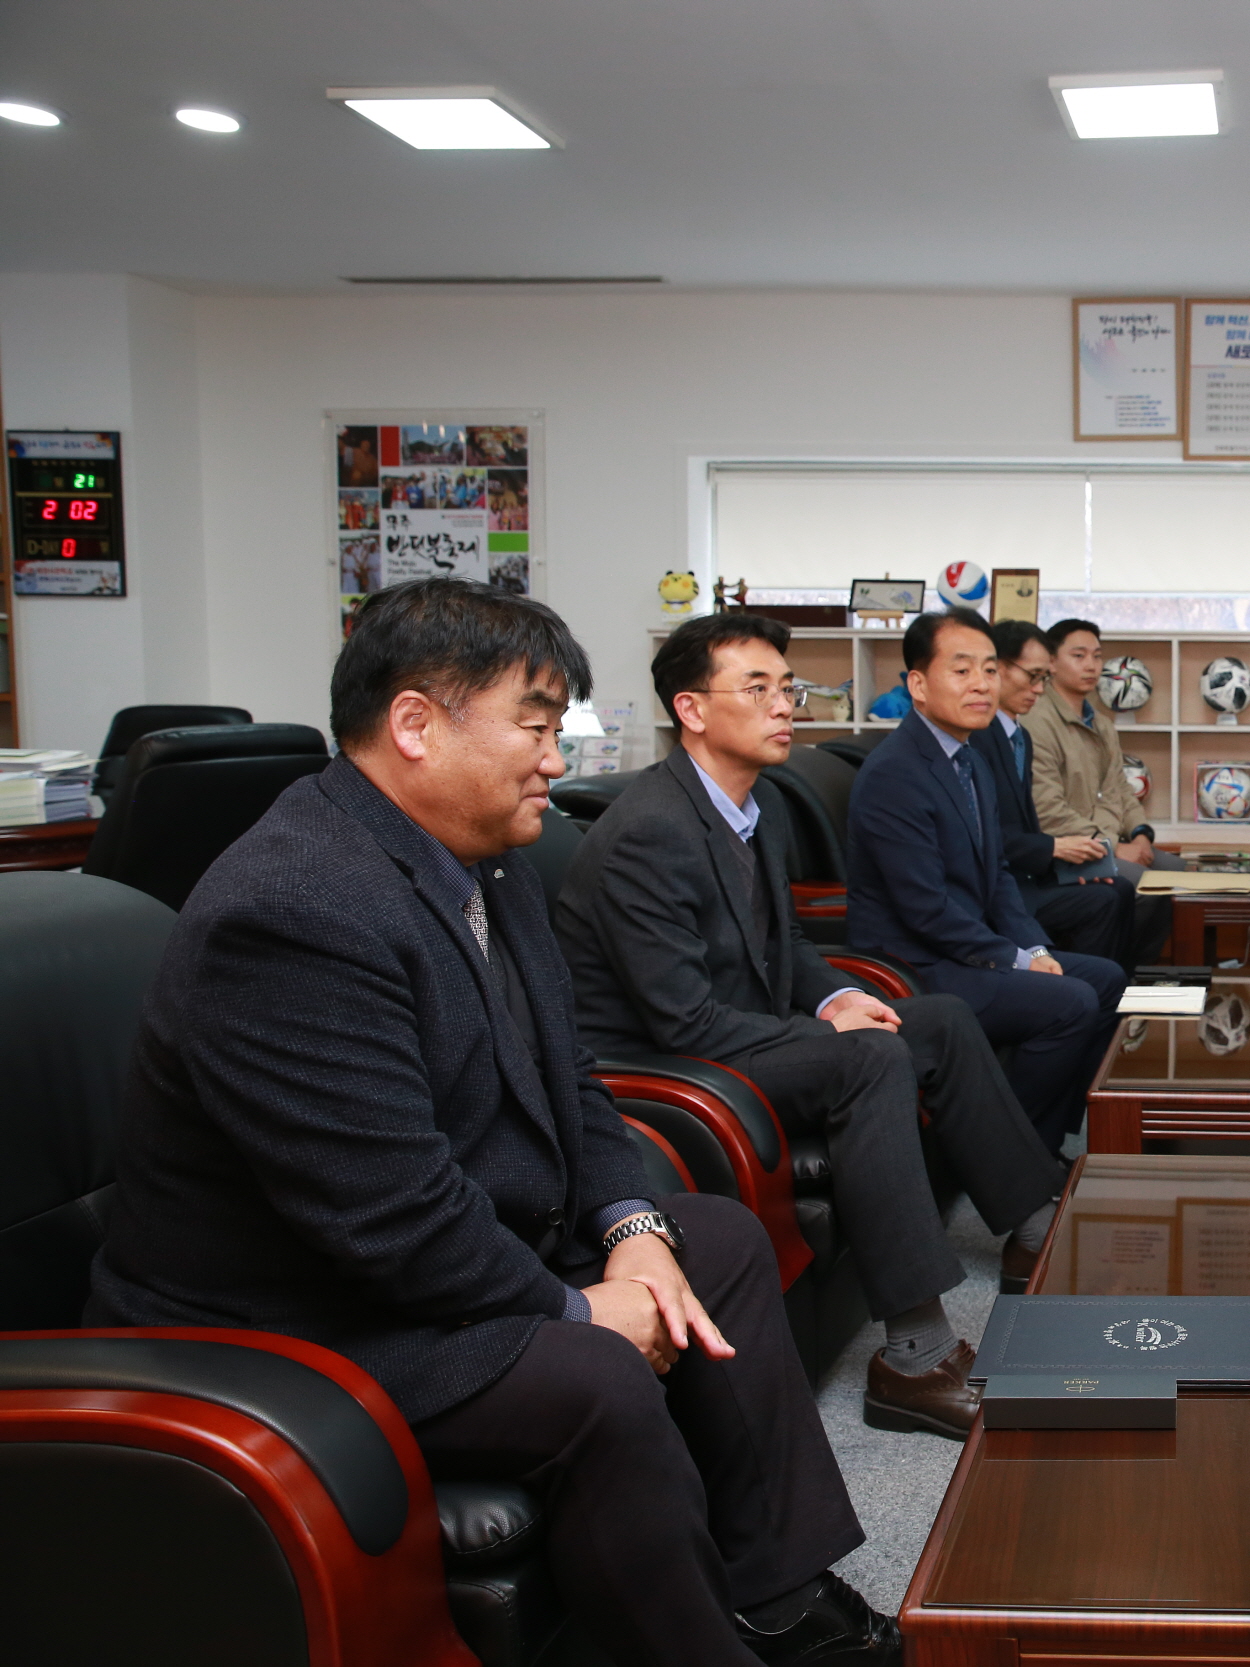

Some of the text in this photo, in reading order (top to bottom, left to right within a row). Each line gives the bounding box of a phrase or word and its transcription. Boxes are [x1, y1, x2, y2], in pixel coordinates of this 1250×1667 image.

[1204, 315, 1226, 326] 함께
[1226, 329, 1247, 341] 함께
[74, 473, 95, 489] 21
[42, 500, 98, 521] 2 02
[386, 514, 410, 531] 무주
[61, 538, 76, 558] 0
